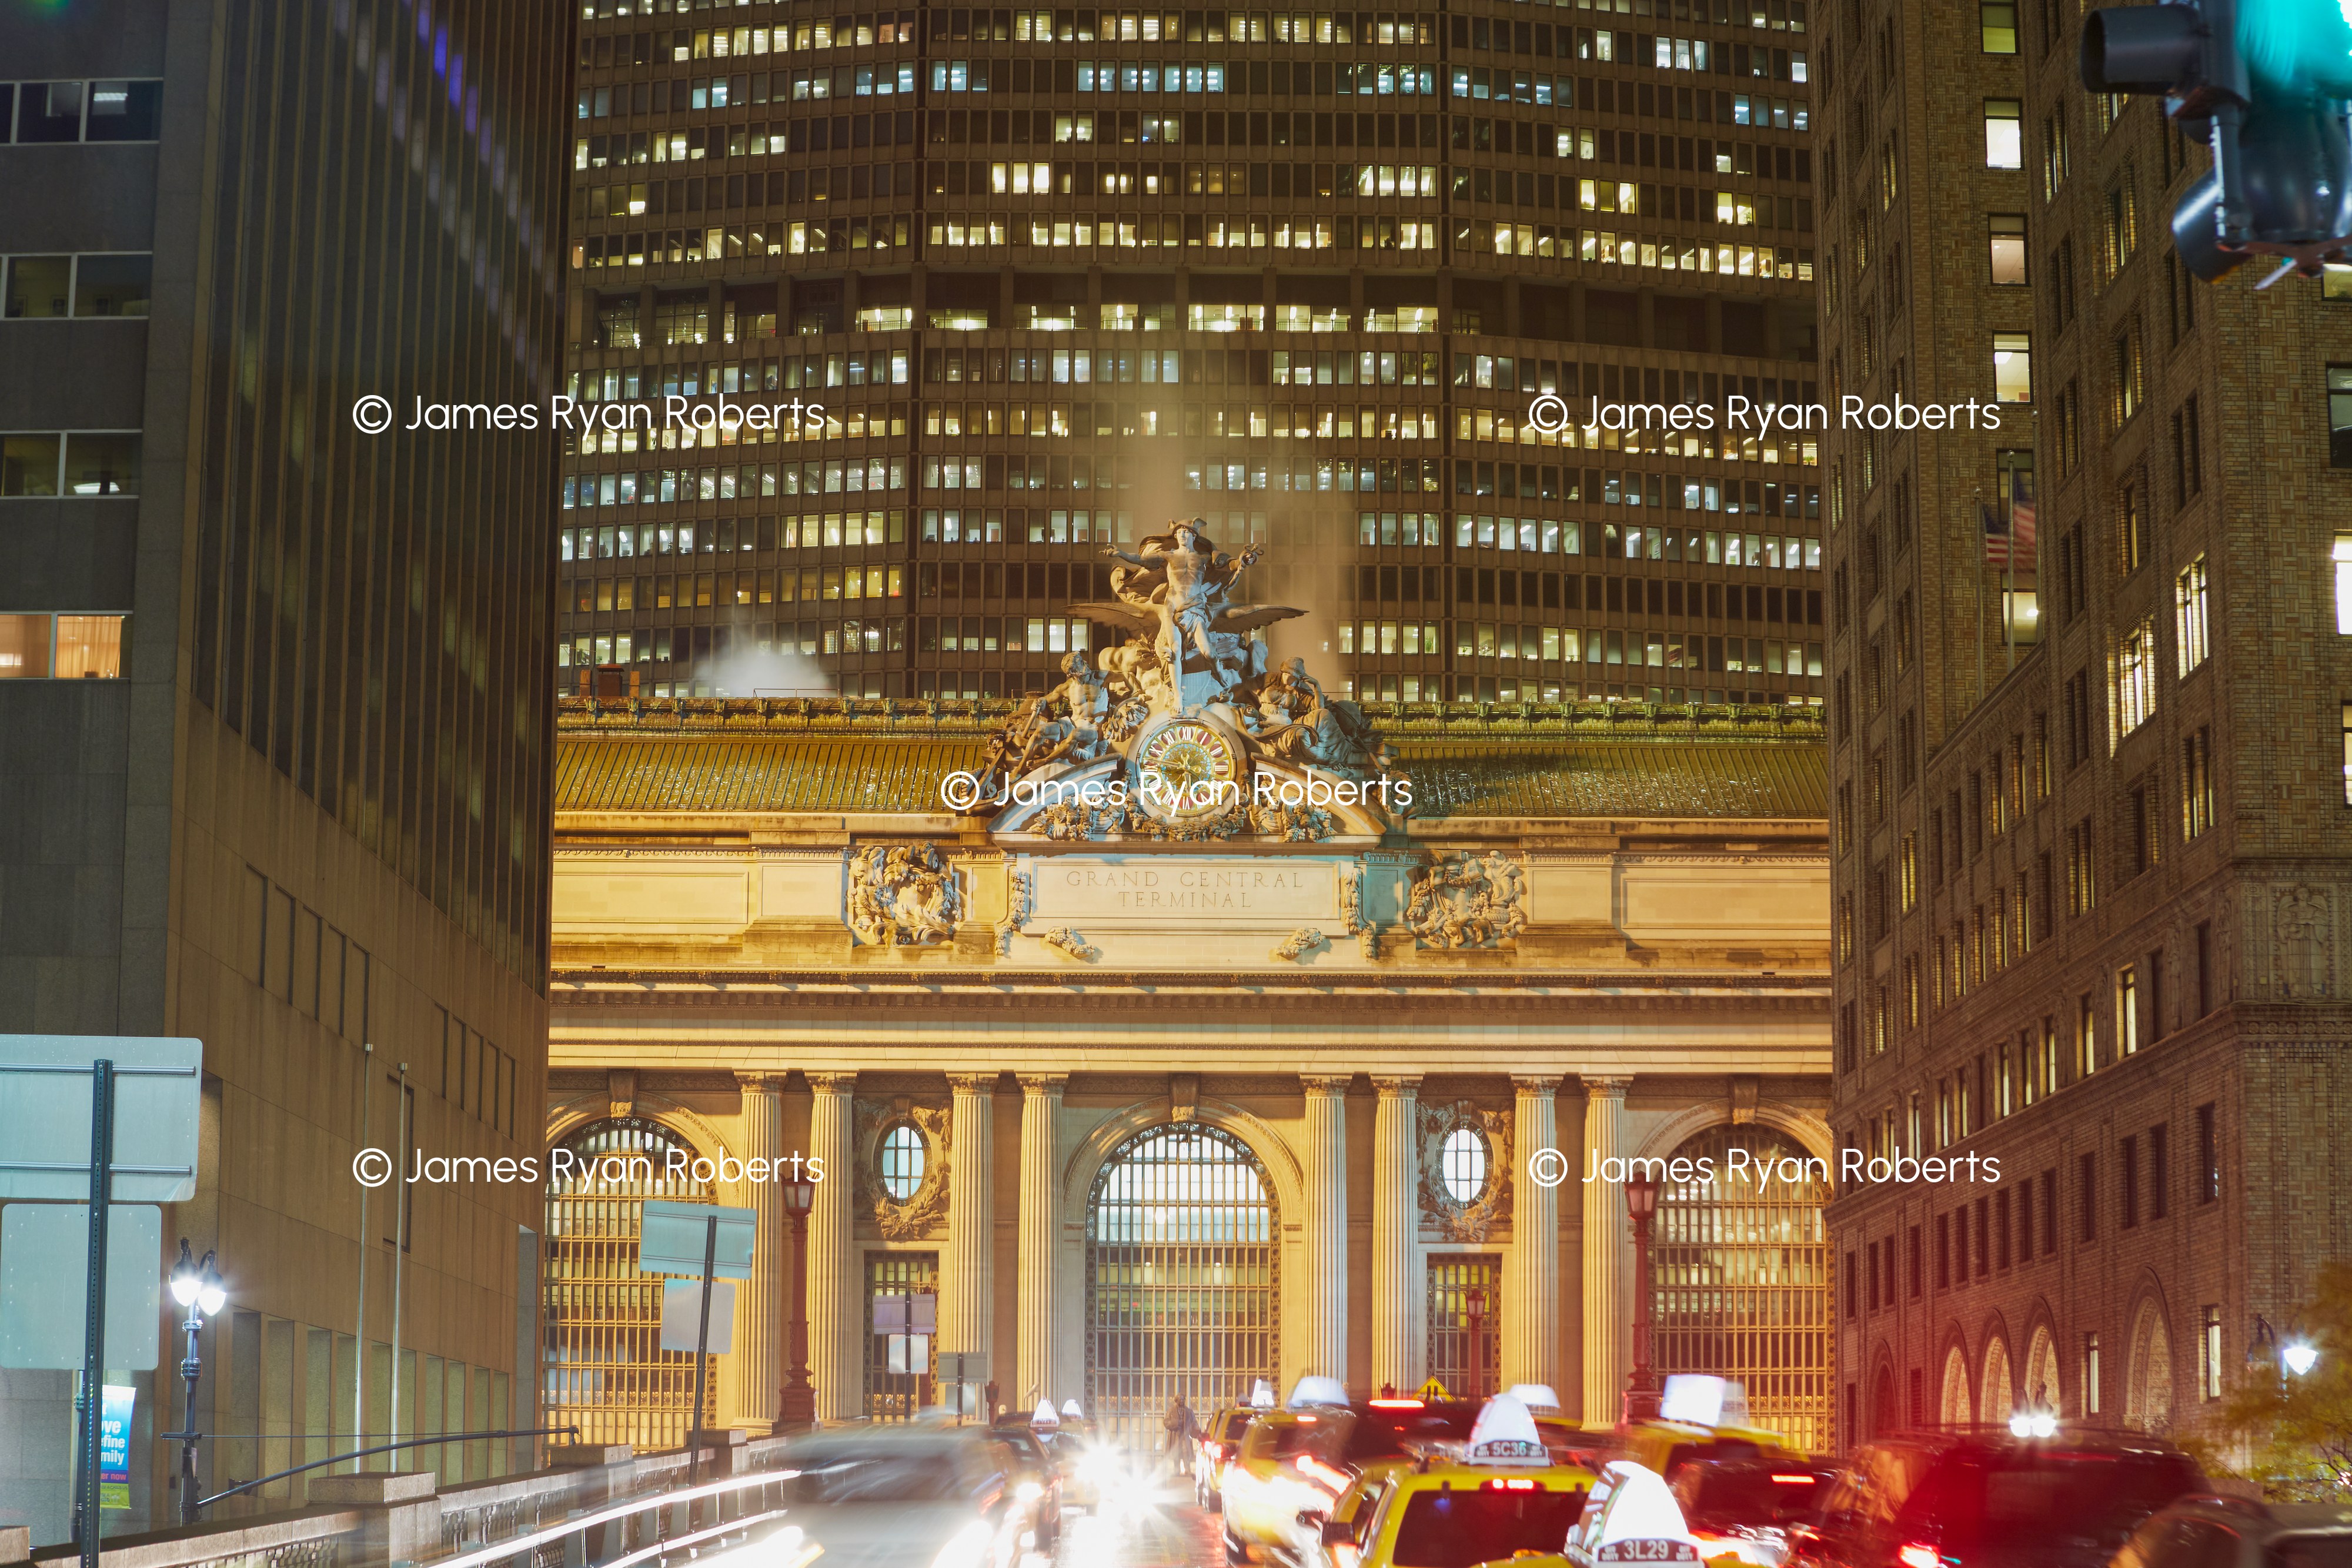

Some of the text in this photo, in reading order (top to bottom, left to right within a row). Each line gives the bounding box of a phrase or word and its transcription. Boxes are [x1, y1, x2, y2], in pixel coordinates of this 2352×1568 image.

[1066, 871, 1304, 887] GRAND CENTRAL
[1118, 891, 1252, 908] TERMINAL
[1492, 1442, 1527, 1456] 5C36
[1624, 1540, 1669, 1560] 3L29
